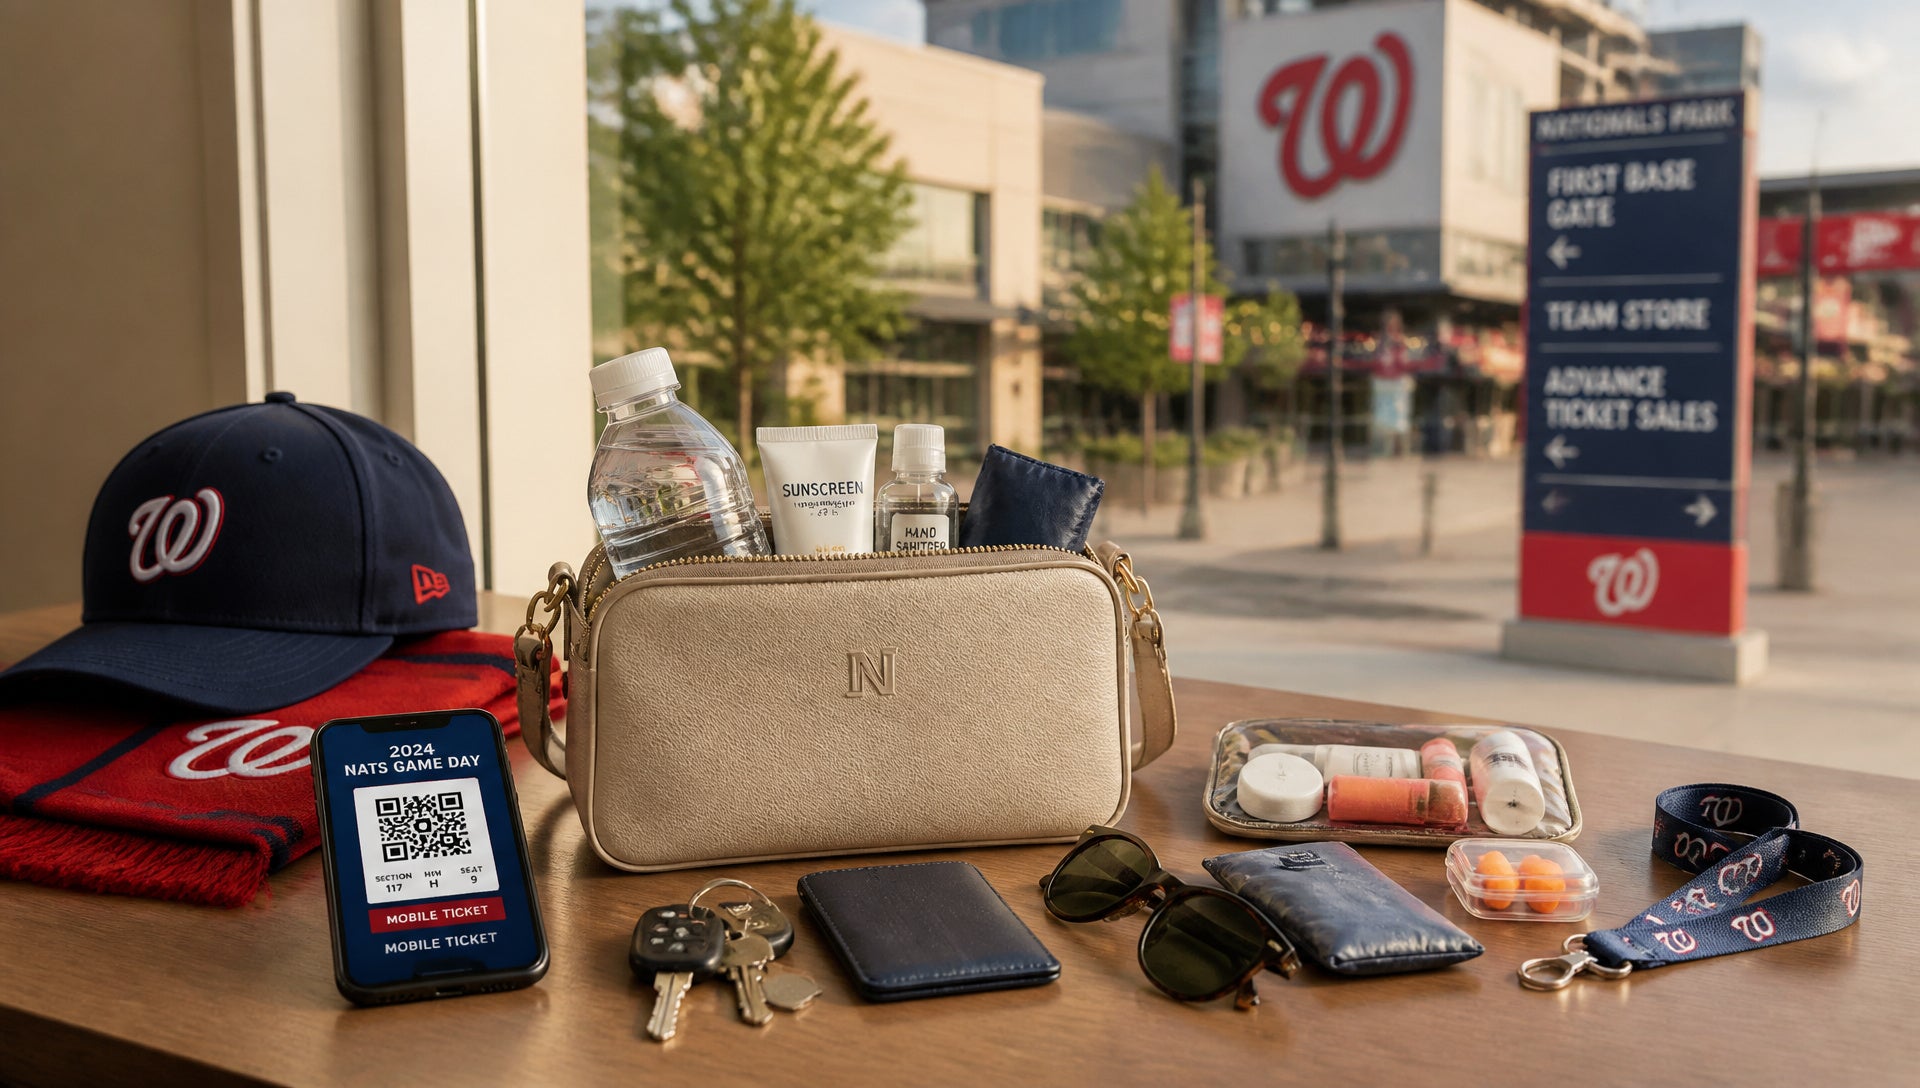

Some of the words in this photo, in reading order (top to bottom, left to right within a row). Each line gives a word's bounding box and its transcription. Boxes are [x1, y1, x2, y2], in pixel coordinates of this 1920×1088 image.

[1258, 31, 1414, 199] W
[1669, 99, 1735, 131] PARK
[1548, 163, 1619, 196] FIRST
[1624, 158, 1696, 193] BASE
[1547, 197, 1615, 229] GATE
[1546, 300, 1618, 330] TEAM
[1622, 298, 1711, 330] STORE
[1544, 366, 1666, 397] ADVANCE
[1544, 398, 1633, 430] TICKET
[1635, 400, 1718, 432] SALES
[782, 481, 864, 498] SUNSCREEN
[128, 486, 225, 585] W
[1587, 548, 1659, 617] W
[843, 646, 898, 698] N
[344, 762, 388, 776] NATS
[393, 757, 443, 773] GAME
[448, 754, 480, 768] DAY
[389, 743, 435, 758] 2024
[375, 872, 412, 882] SECTION
[460, 866, 483, 875] SEAT
[386, 883, 403, 893] 117
[429, 879, 439, 888] H
[470, 875, 478, 884] 9
[386, 911, 438, 925] MOBILE
[442, 905, 488, 920] TICKET
[385, 938, 440, 954] MOBILE
[445, 932, 498, 948] TICKET
